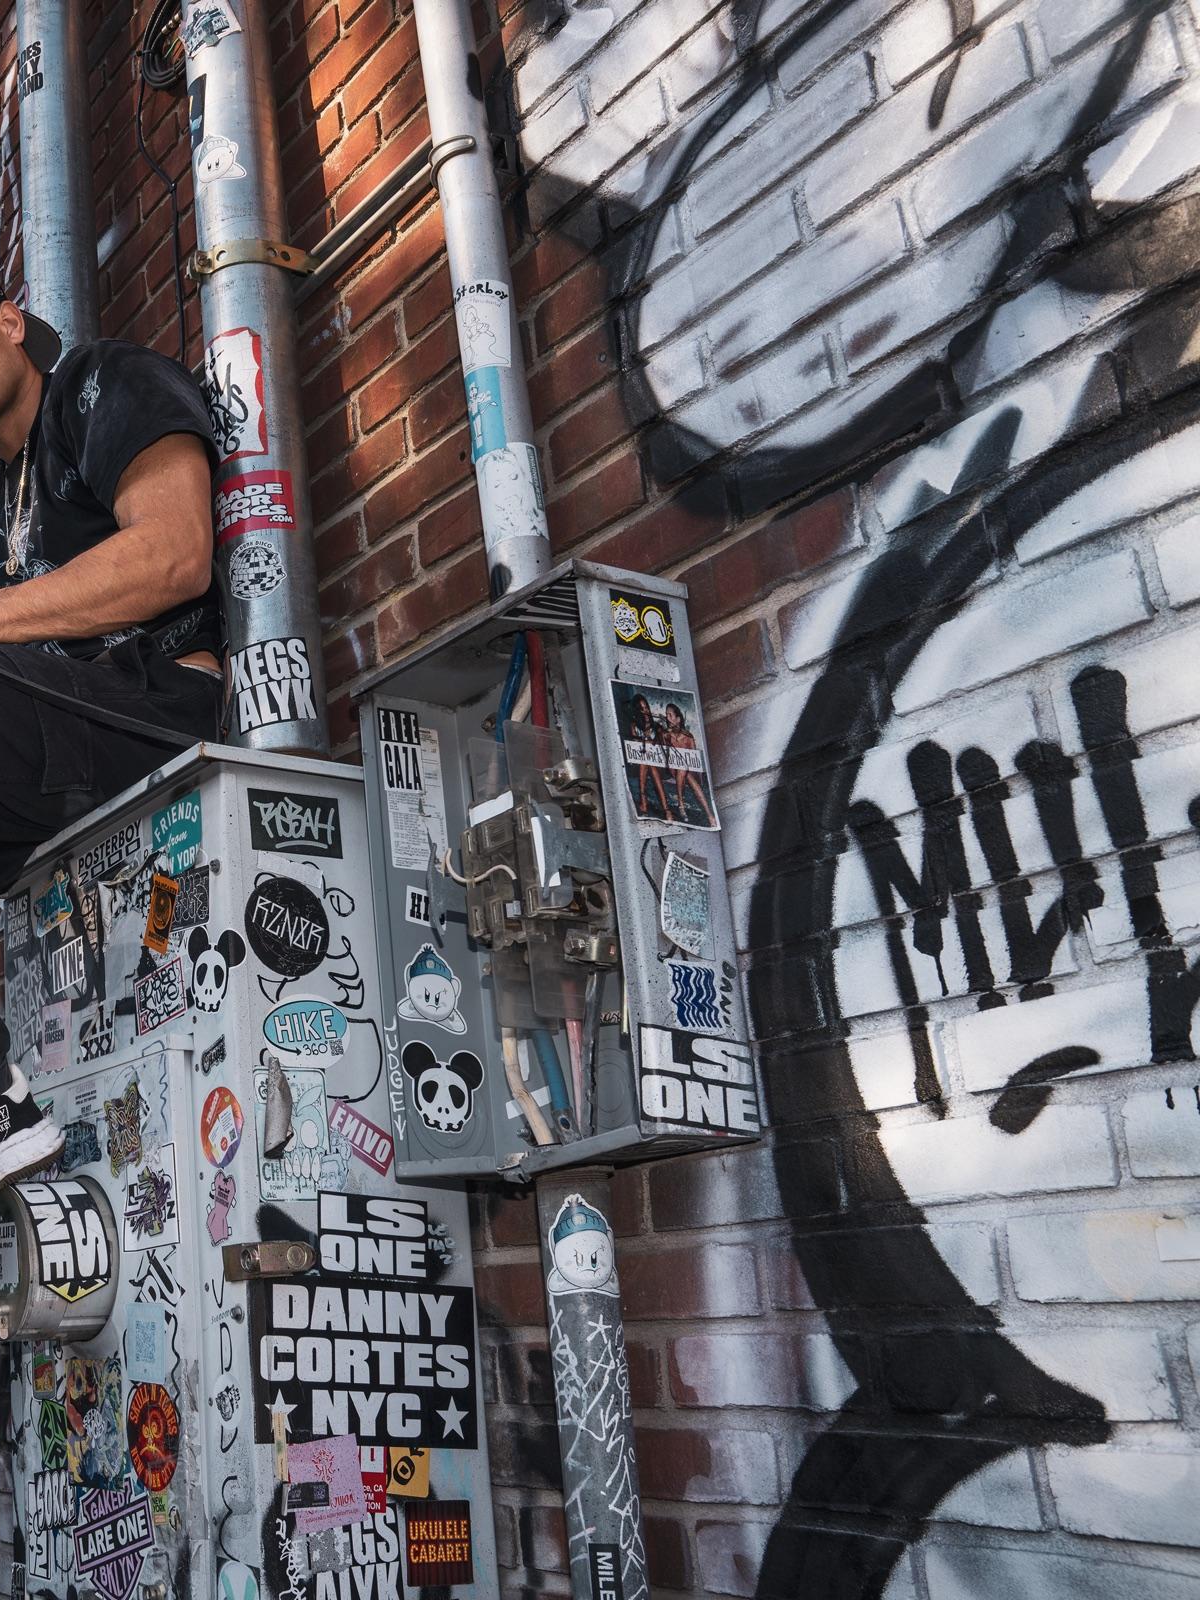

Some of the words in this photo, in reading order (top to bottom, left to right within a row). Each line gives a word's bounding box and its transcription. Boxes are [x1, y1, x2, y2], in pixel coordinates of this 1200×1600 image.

[217, 505, 287, 533] KINGS
[220, 494, 273, 520] FOR
[230, 638, 310, 694] KEGS
[238, 678, 317, 733] ALYK
[380, 709, 419, 744] FREE
[384, 743, 422, 791] GAZA
[78, 816, 142, 875] POSTERBOY
[154, 802, 199, 843] FRIENDS
[78, 838, 141, 887] 2000
[274, 1009, 337, 1043] HIKE
[641, 1026, 753, 1085] LS
[642, 1074, 760, 1132] ONE
[15, 1182, 75, 1282] ONE
[47, 1180, 109, 1279] LS
[320, 1193, 425, 1238] LS
[320, 1234, 427, 1278] ONE
[272, 1283, 455, 1338] DANNY
[260, 1335, 470, 1389] CORTES
[311, 1389, 422, 1439] NYC
[152, 1503, 166, 1512] YORK
[374, 1484, 383, 1492] CA
[79, 1525, 114, 1562] LARE
[117, 1509, 148, 1546] ONE
[409, 1520, 469, 1541] UKULELE
[409, 1543, 469, 1564] CABARET
[100, 1553, 135, 1598] BKLYN
